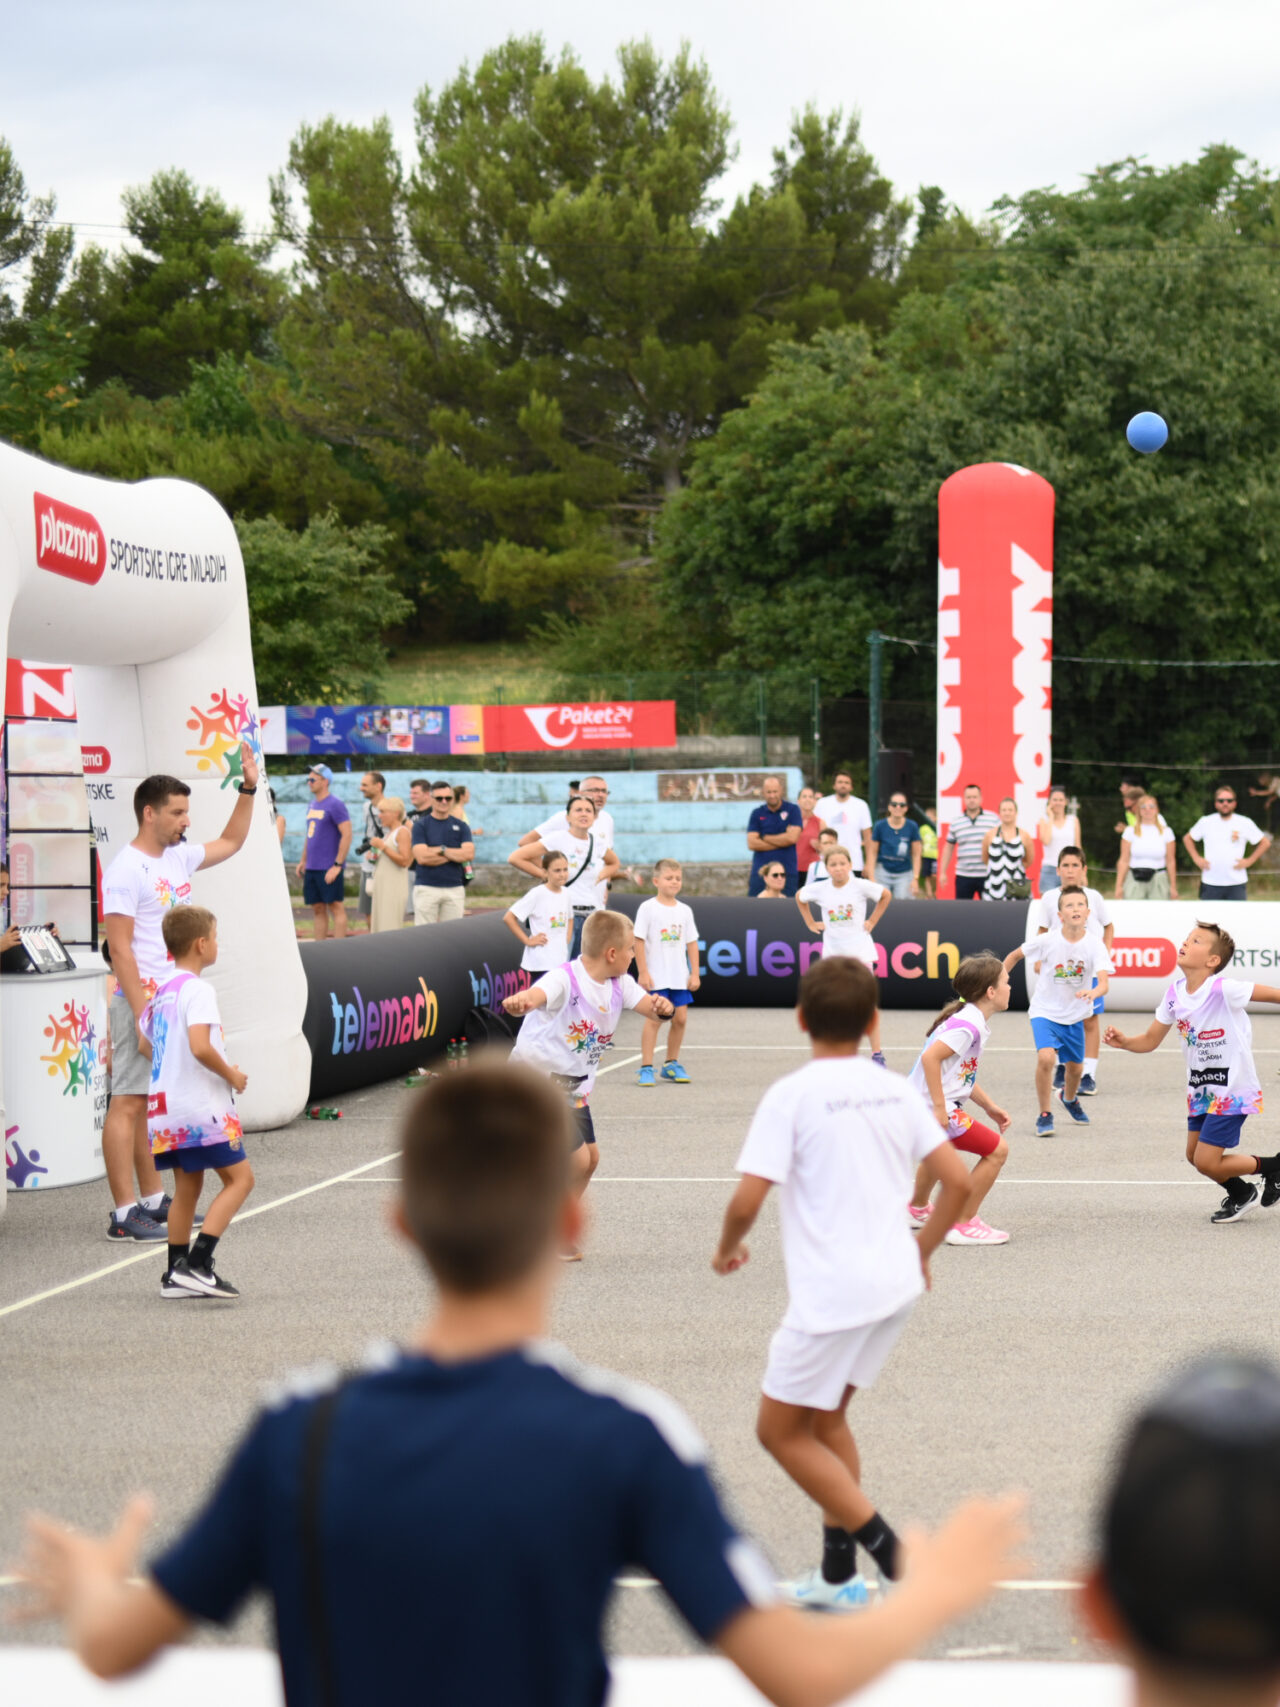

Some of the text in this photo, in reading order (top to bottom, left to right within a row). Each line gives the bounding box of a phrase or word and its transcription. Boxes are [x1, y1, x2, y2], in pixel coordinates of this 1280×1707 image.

[40, 508, 227, 583] plazma SPORTSKE IGRE MLADIH
[330, 976, 438, 1055] telemach
